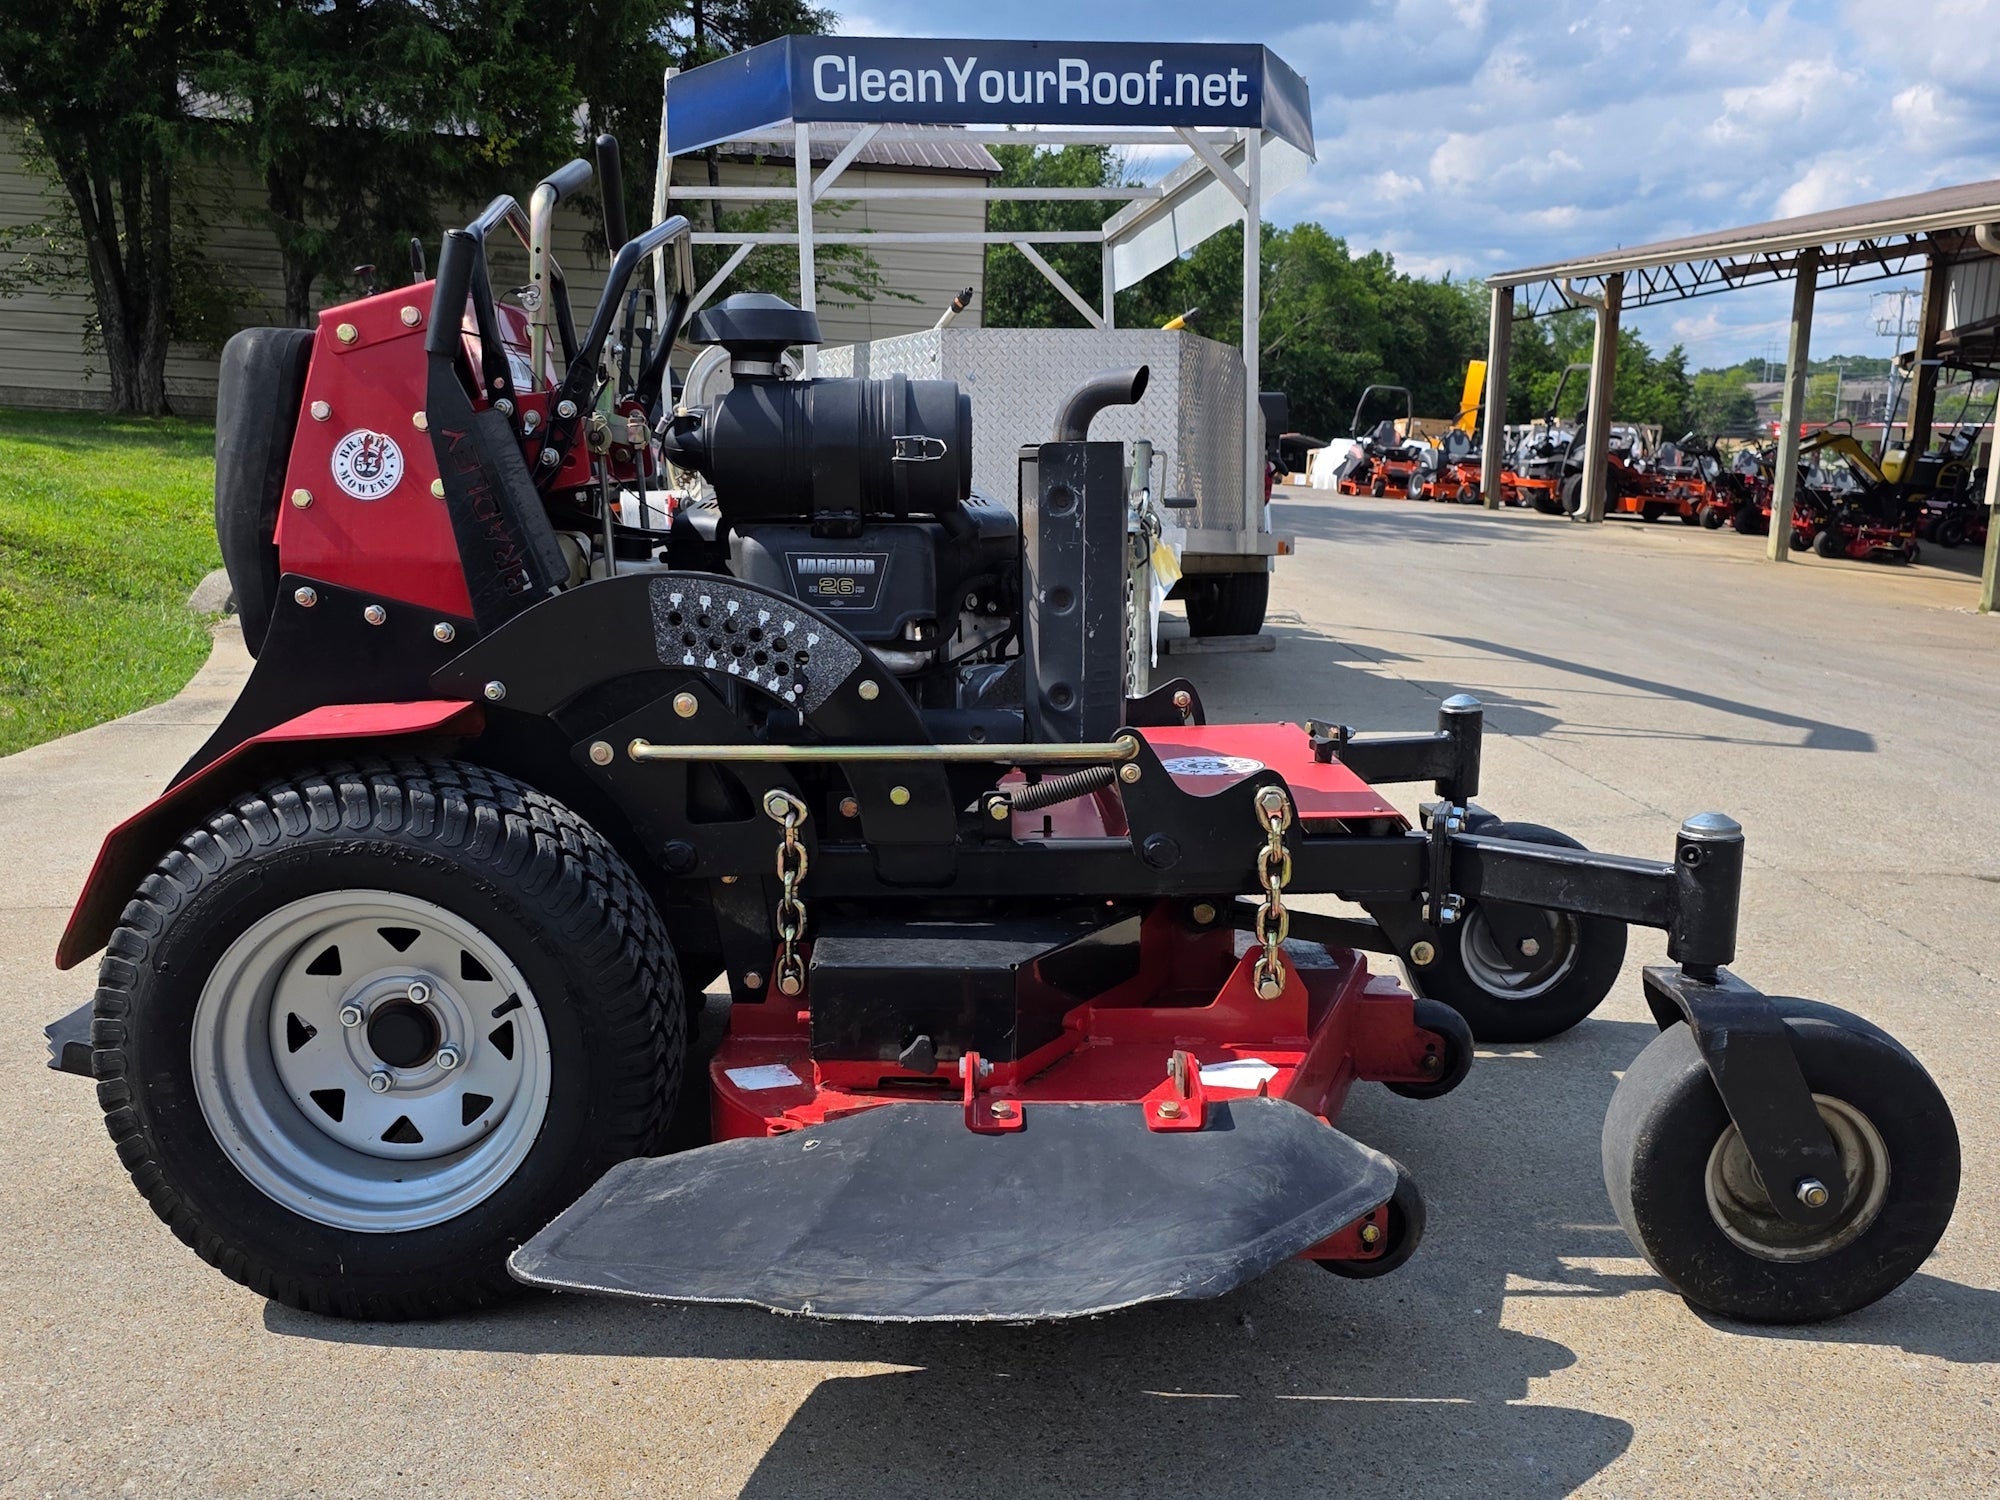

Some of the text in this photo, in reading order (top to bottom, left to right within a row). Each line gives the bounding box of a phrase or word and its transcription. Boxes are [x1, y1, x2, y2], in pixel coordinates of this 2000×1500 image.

[813, 54, 1249, 107] CleanYourRoof.net
[339, 469, 394, 494] MOWERS
[441, 427, 533, 596] BRADLEY
[797, 558, 875, 575] VANGUARD
[818, 577, 854, 595] 26
